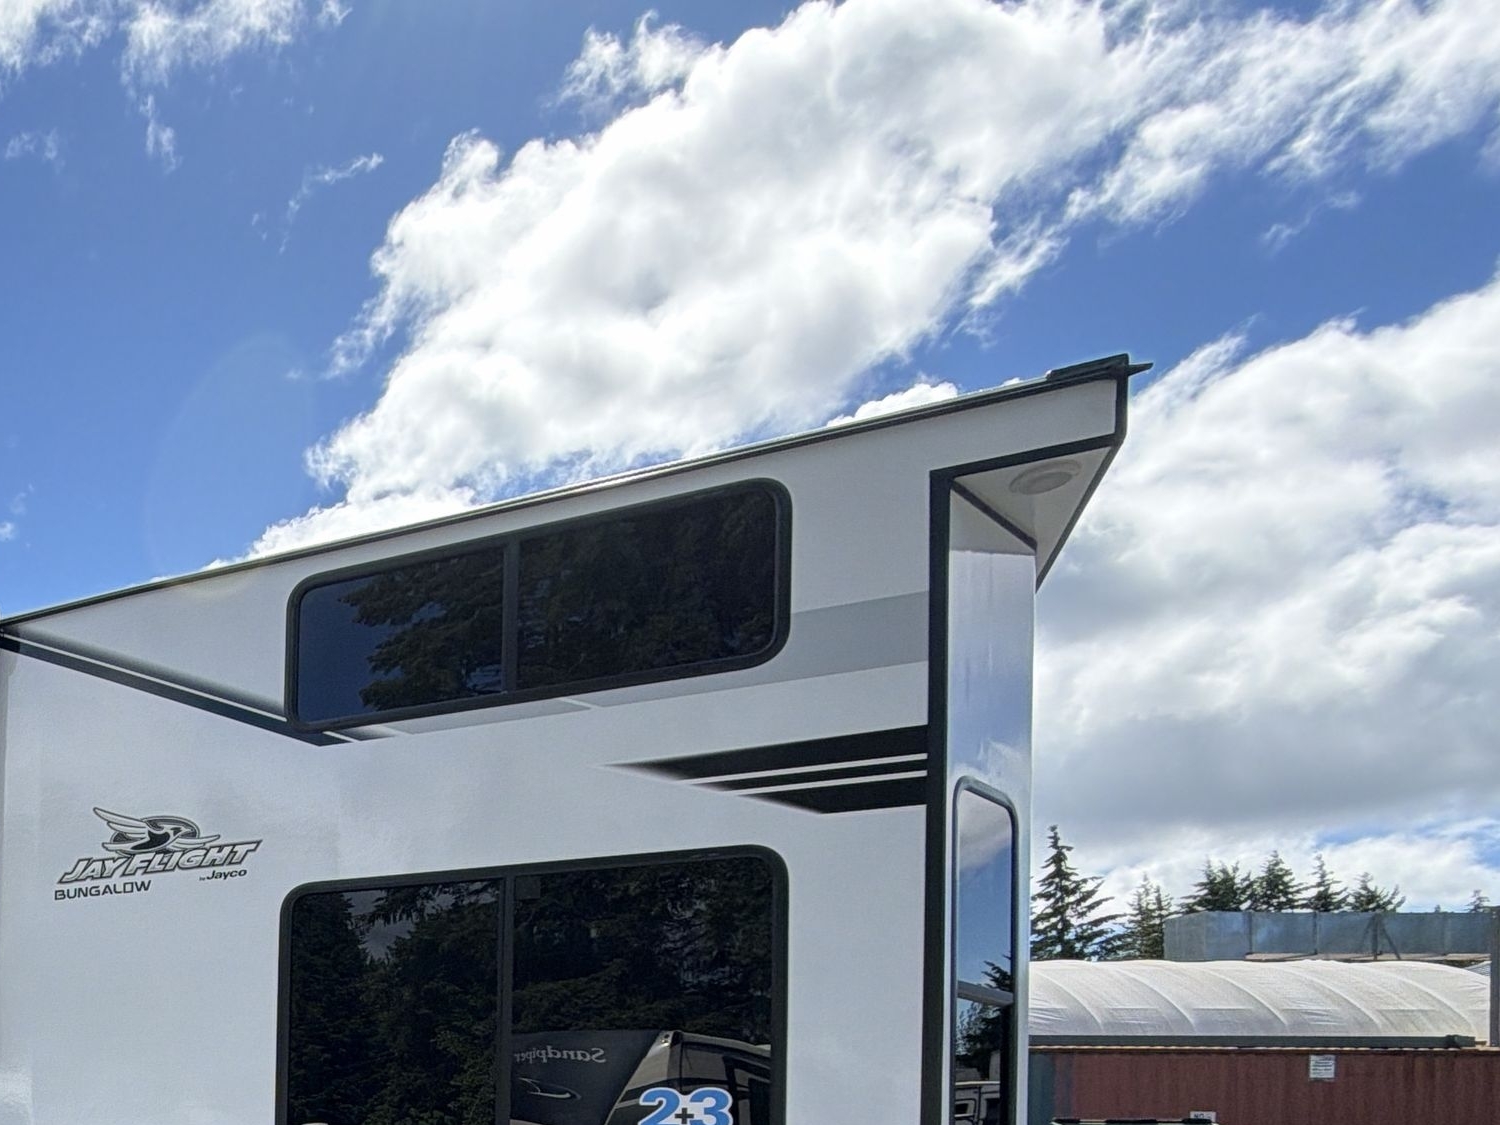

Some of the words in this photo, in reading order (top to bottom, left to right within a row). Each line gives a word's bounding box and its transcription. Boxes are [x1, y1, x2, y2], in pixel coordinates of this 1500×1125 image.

[57, 856, 131, 884] JAY
[123, 840, 263, 876] FLIGHT
[206, 869, 248, 881] Jayco
[54, 880, 151, 900] BUNGALOW
